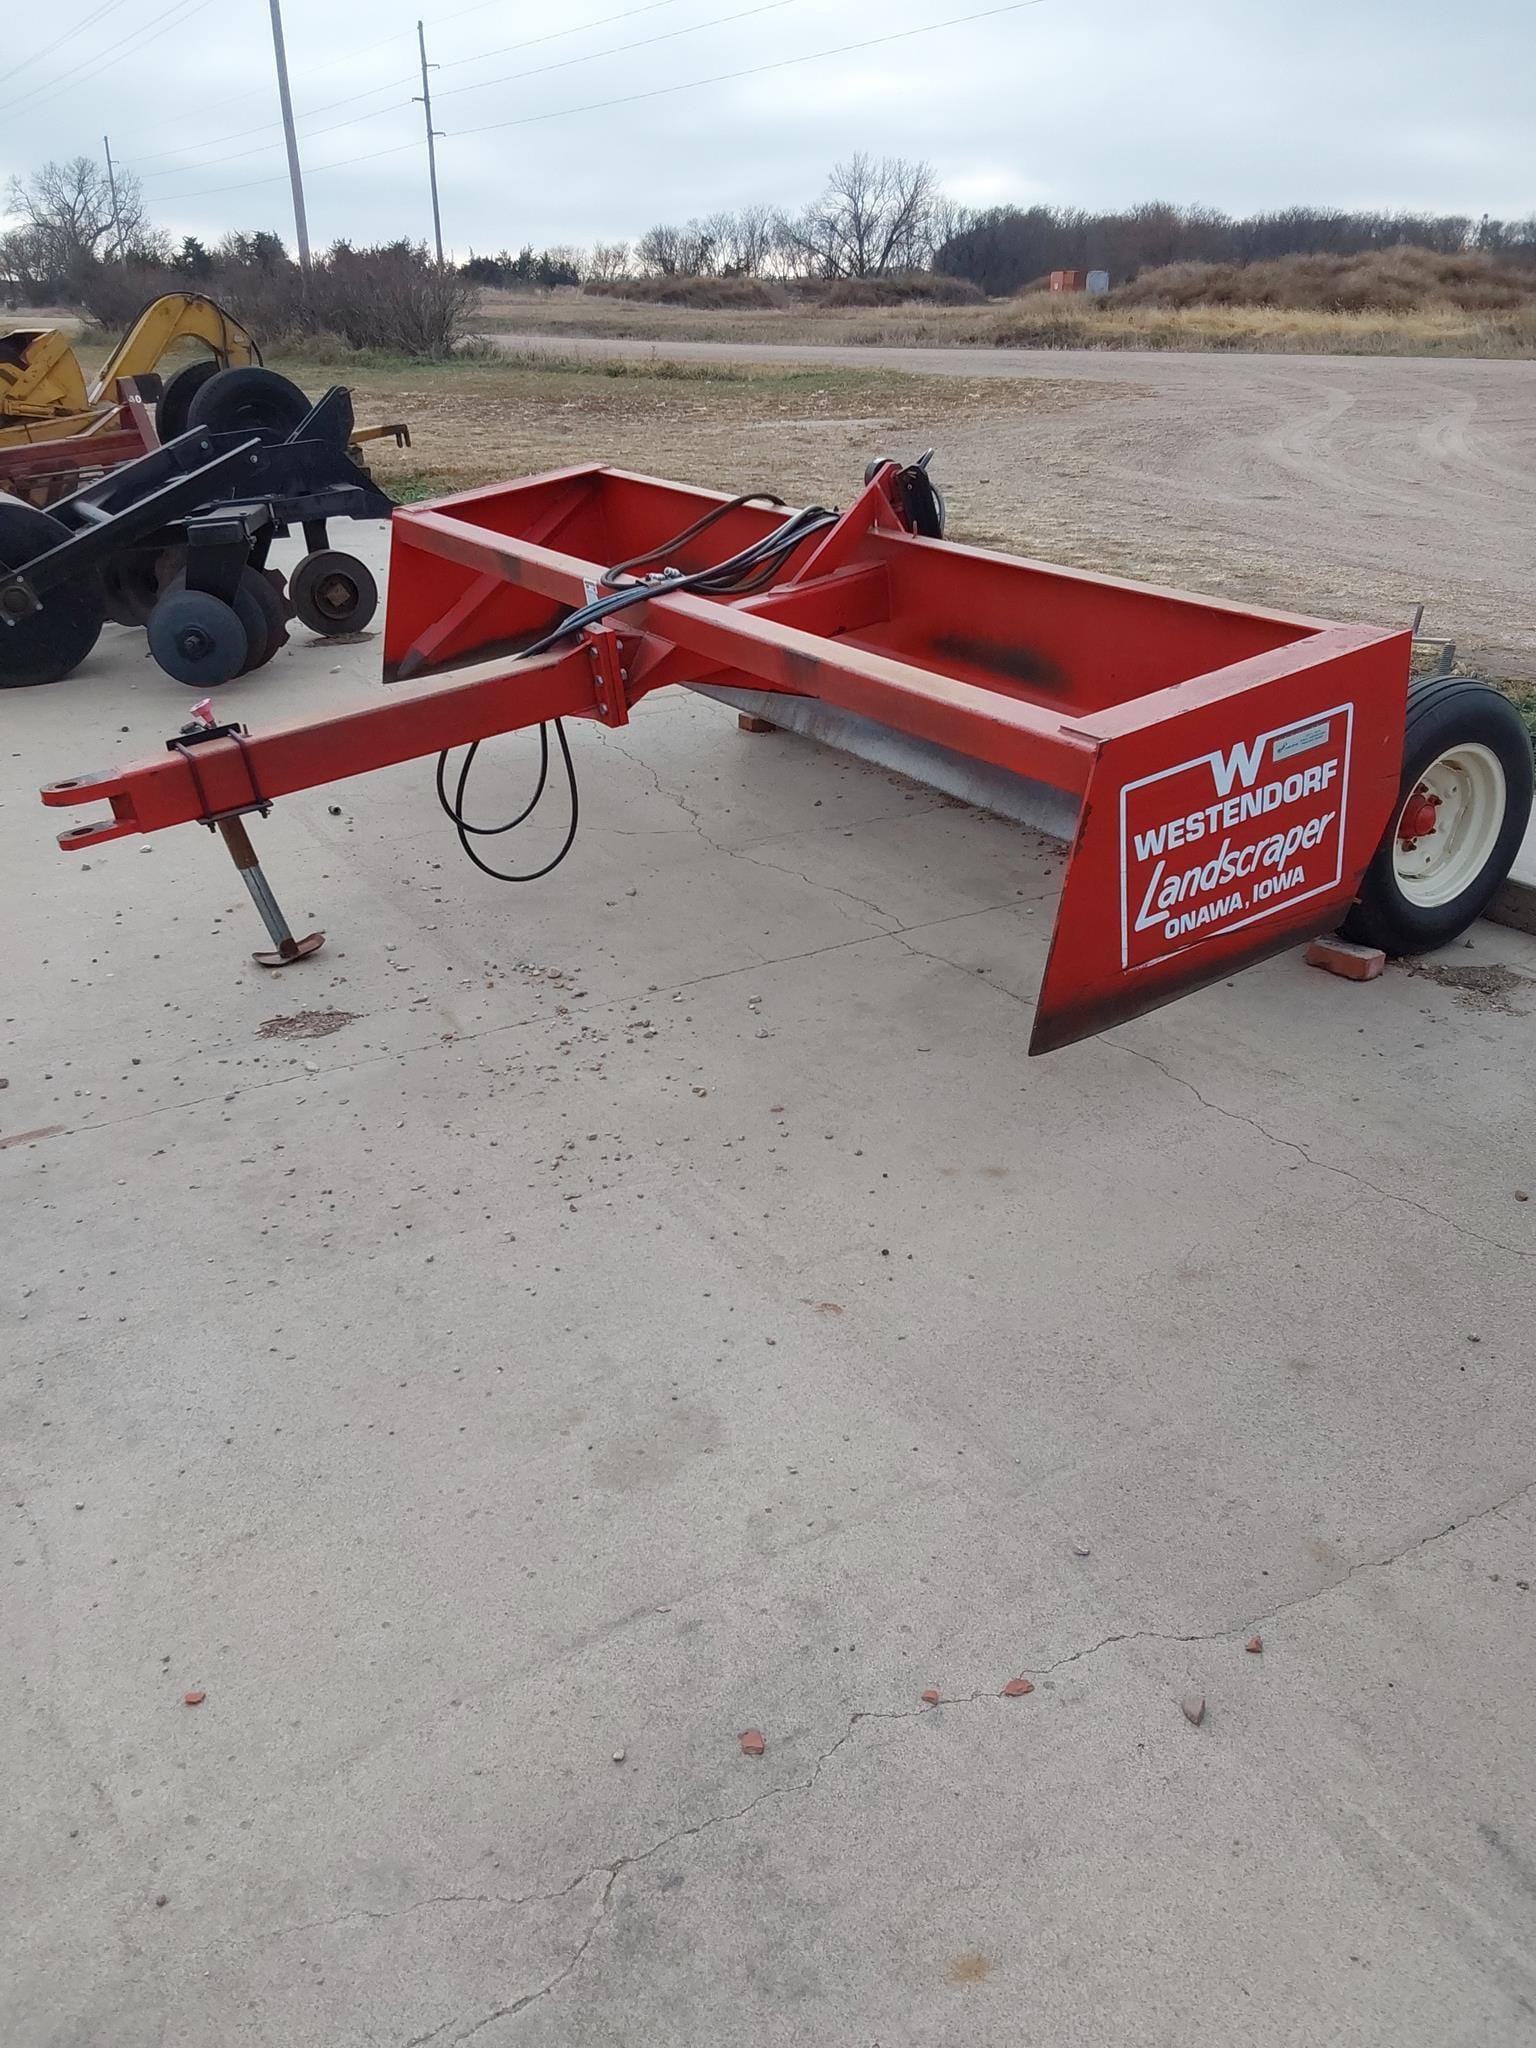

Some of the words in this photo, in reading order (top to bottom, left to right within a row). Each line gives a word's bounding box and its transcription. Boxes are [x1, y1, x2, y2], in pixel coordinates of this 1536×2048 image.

[1209, 734, 1268, 797] W
[1134, 759, 1338, 861] WESTENDORF
[1134, 811, 1335, 932] Landscraper
[1252, 865, 1305, 904] IOWA
